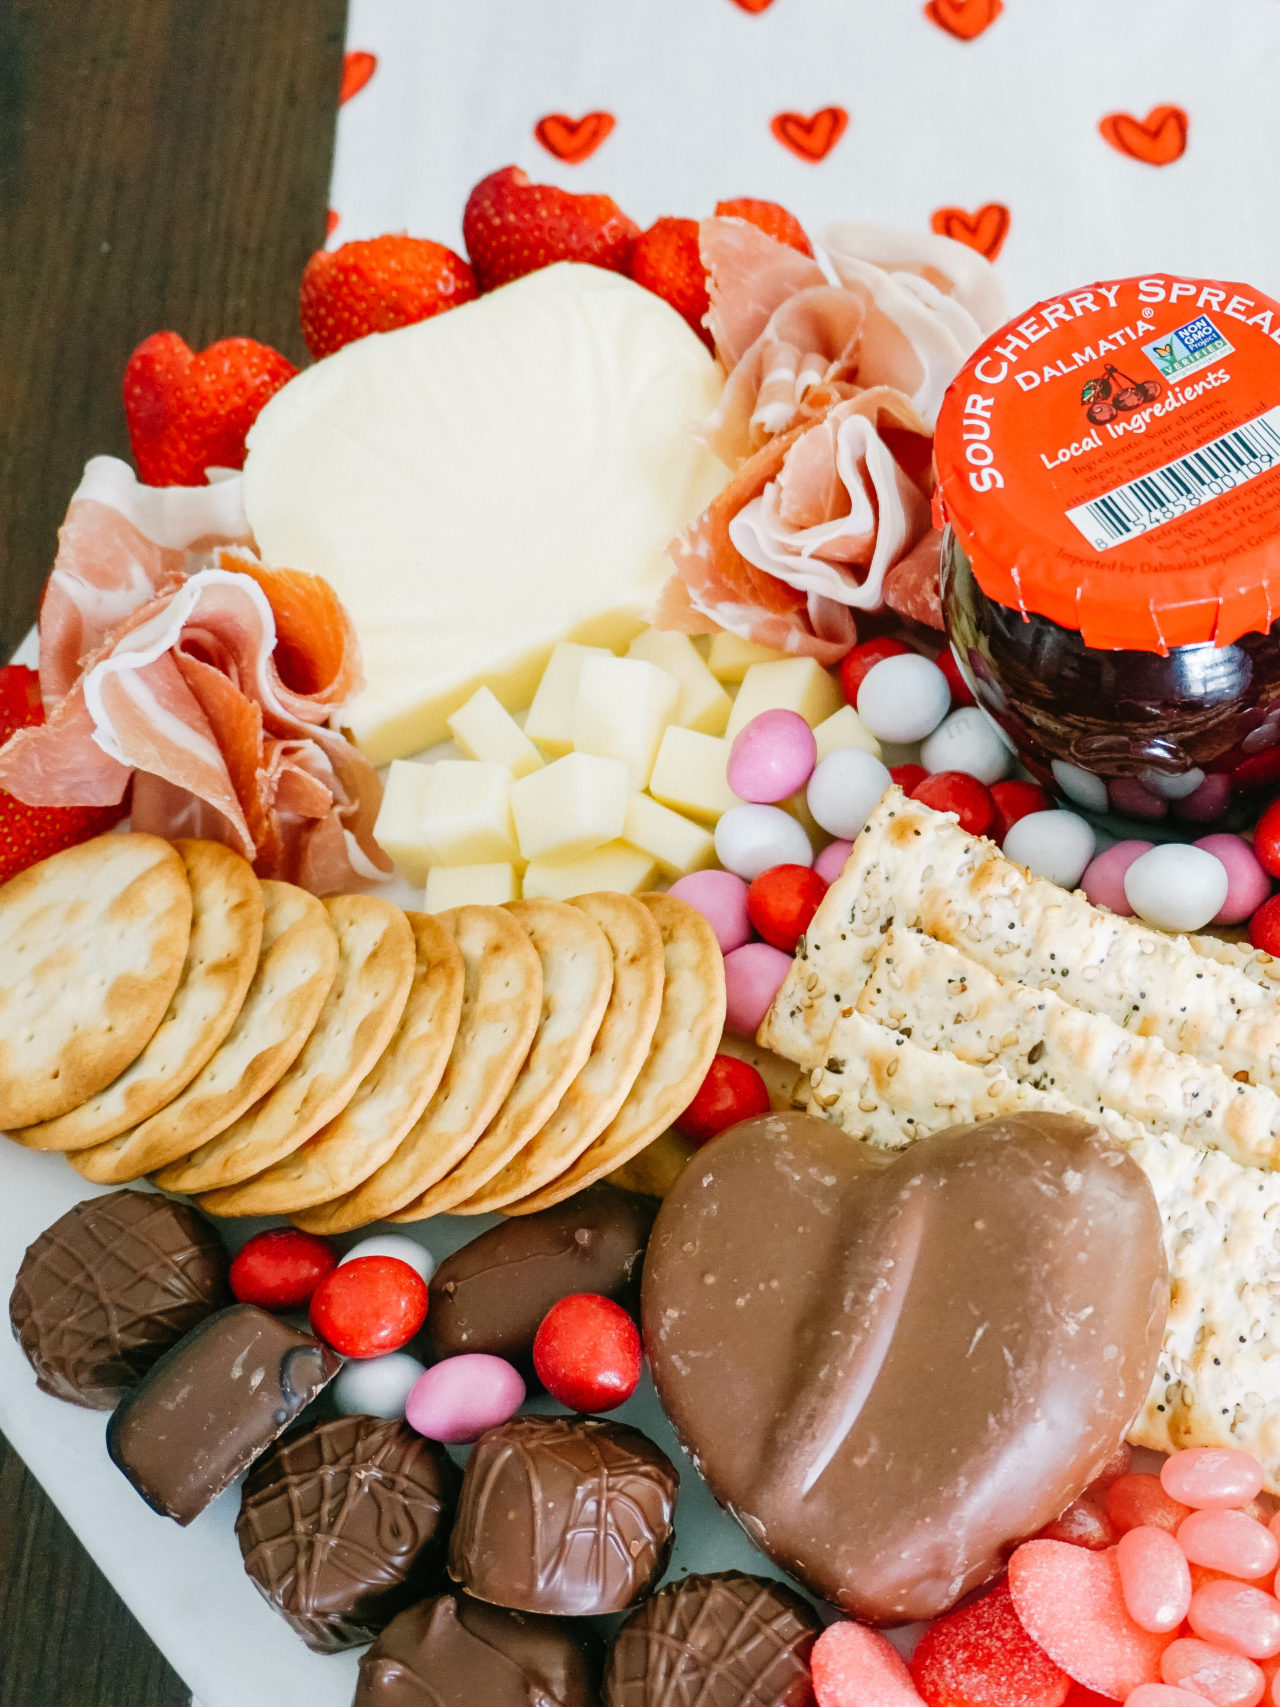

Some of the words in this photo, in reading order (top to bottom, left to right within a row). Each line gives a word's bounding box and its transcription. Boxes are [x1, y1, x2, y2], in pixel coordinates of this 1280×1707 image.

[972, 285, 1121, 384] CHERRY
[1178, 318, 1208, 338] NON
[1184, 326, 1213, 345] GMO
[1188, 333, 1218, 351] Project
[1163, 339, 1224, 374] VERIFIED
[1040, 428, 1103, 469] Local
[1105, 368, 1231, 440] Ingredients
[1243, 400, 1269, 421] acid
[963, 394, 1004, 492] SOUR
[1095, 538, 1108, 549] 8
[1132, 493, 1201, 533] 54858
[1207, 452, 1273, 495] 00109
[1140, 560, 1200, 575] Dalmatia
